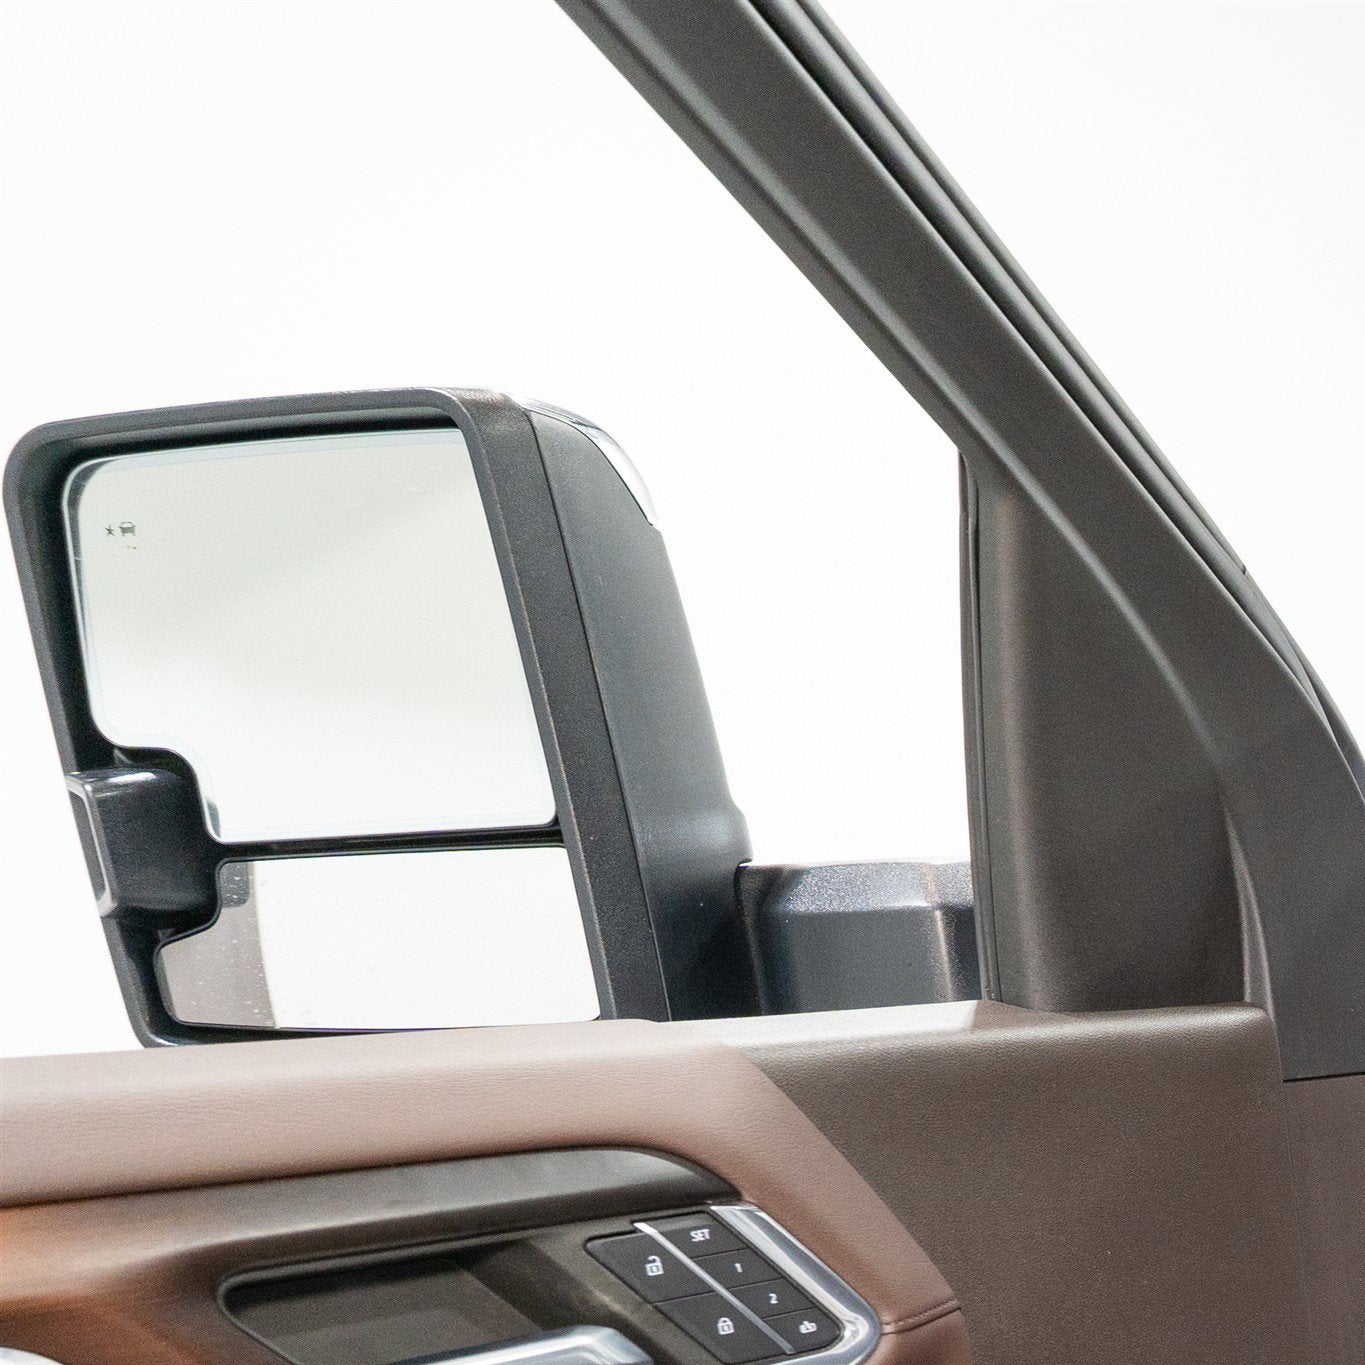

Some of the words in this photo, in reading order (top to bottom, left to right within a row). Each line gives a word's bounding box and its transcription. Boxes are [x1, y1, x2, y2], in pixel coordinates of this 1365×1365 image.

[690, 1228, 711, 1242] SET
[734, 1262, 743, 1273] 1
[768, 1293, 778, 1304] 2
